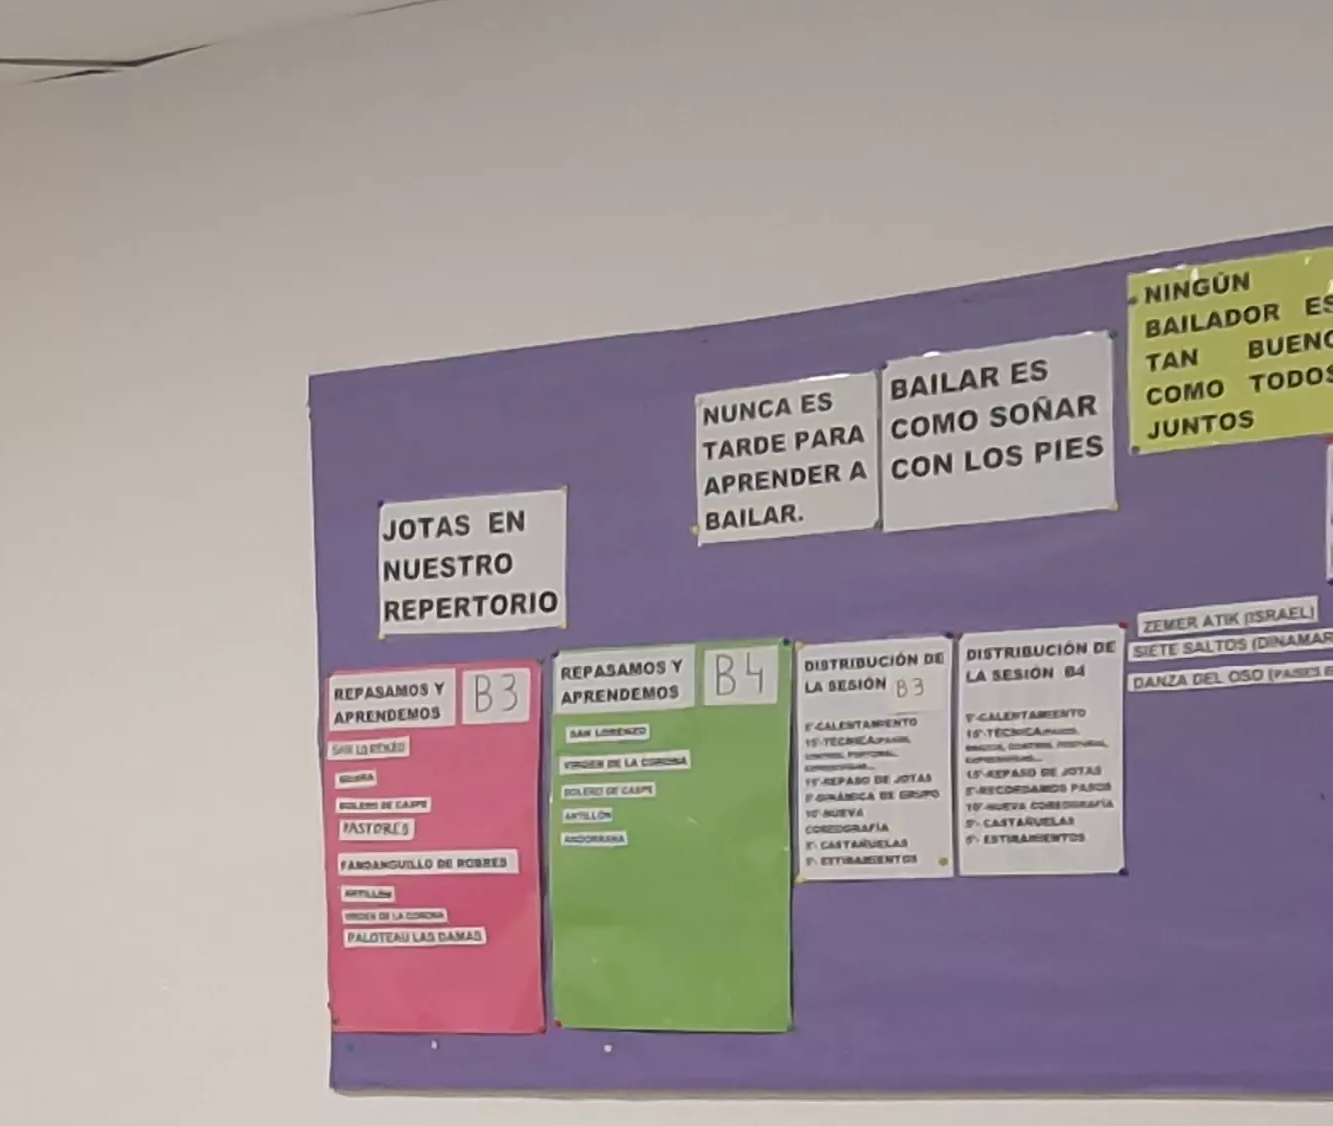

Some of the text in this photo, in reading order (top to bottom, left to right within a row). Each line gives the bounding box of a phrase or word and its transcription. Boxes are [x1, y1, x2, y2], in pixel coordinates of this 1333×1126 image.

[1144, 271, 1250, 304] NINGÚN
[1145, 295, 1333, 338] BAILADOR ES
[1145, 348, 1198, 372] TAN
[890, 359, 1048, 400] BAILAR ES
[1146, 379, 1224, 406] COMO
[703, 392, 833, 426] NUNCA ES
[891, 394, 1097, 439] COMO SOÑAR
[1147, 409, 1254, 440] JUNTOS
[702, 424, 865, 460] TARDE PARA
[891, 435, 1104, 480] CON LOS PIES
[704, 461, 867, 497] APRENDER A
[382, 510, 525, 541] JOTAS EN
[705, 503, 804, 530] BAILAR.
[384, 553, 513, 582] NUESTRO
[384, 591, 558, 622] REPERTORIO
[1143, 617, 1198, 634] ZEMER
[1203, 613, 1239, 629] ATIK
[804, 651, 945, 672] DISTRIBUCIÓN DE
[966, 640, 1116, 661] DISTRIBUCIÓN DE
[1133, 641, 1178, 658] SIETE
[1184, 637, 1247, 654] SALTOS
[560, 659, 683, 680] REPASAMOS Y
[715, 651, 764, 697] B4
[966, 670, 986, 684] LA
[992, 665, 1054, 682] SESIÓN
[1133, 673, 1187, 690] DANZA
[1193, 671, 1222, 686] DEL
[1229, 669, 1264, 683] OSO
[334, 681, 445, 701] REPASAMOS Y
[475, 673, 518, 713] B3
[561, 685, 680, 705] APRENDEMOS
[805, 675, 886, 694] LA SESIÓN
[334, 706, 440, 725] APRENDEMOS
